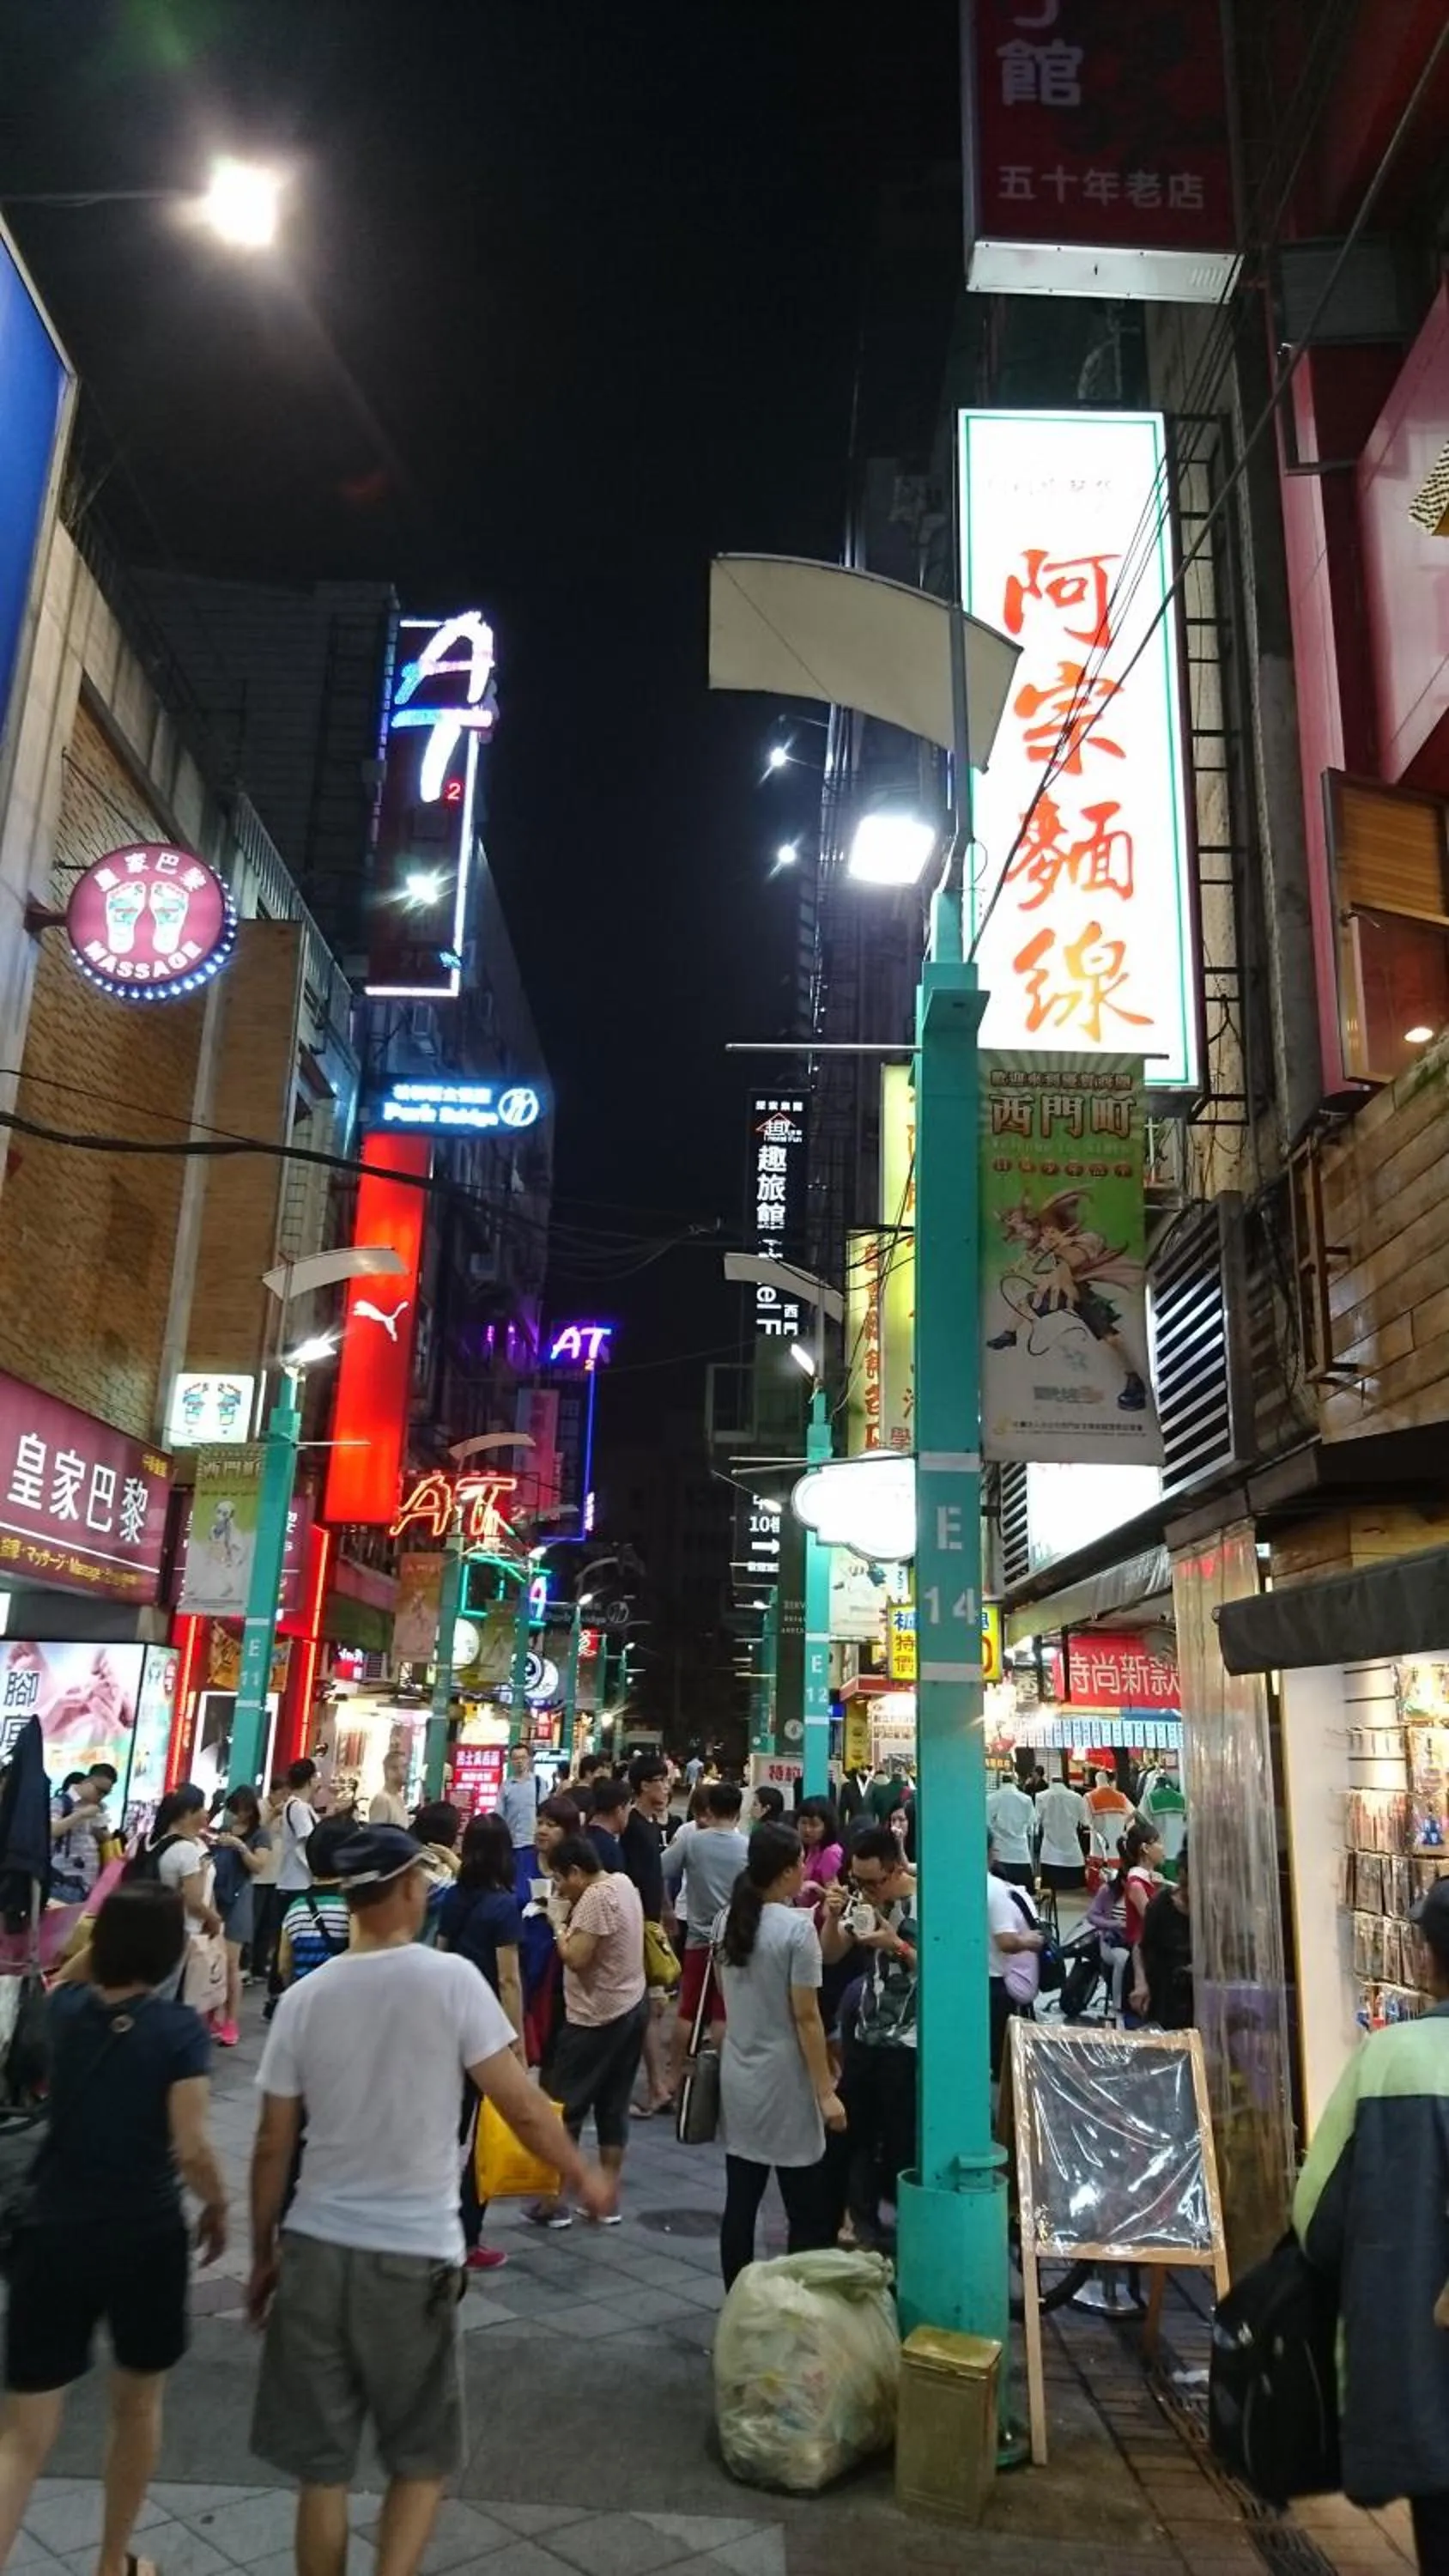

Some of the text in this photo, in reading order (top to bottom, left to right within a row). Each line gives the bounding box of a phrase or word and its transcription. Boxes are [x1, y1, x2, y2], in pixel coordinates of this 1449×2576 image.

[997, 164, 1206, 210] 五十年老店
[446, 781, 463, 800] 2
[1003, 548, 1155, 1045] 阿宗麵線
[84, 939, 203, 980] MASSAGE
[989, 1094, 1137, 1139] 西門町
[756, 1145, 787, 1230] 趣旅館
[7, 1432, 149, 1545] 皇家巴黎
[937, 1506, 962, 1550] E
[924, 1586, 976, 1625] 14
[248, 1641, 260, 1657] E
[811, 1656, 823, 1674] E
[240, 1671, 259, 1686] 11
[807, 1687, 828, 1704] 12
